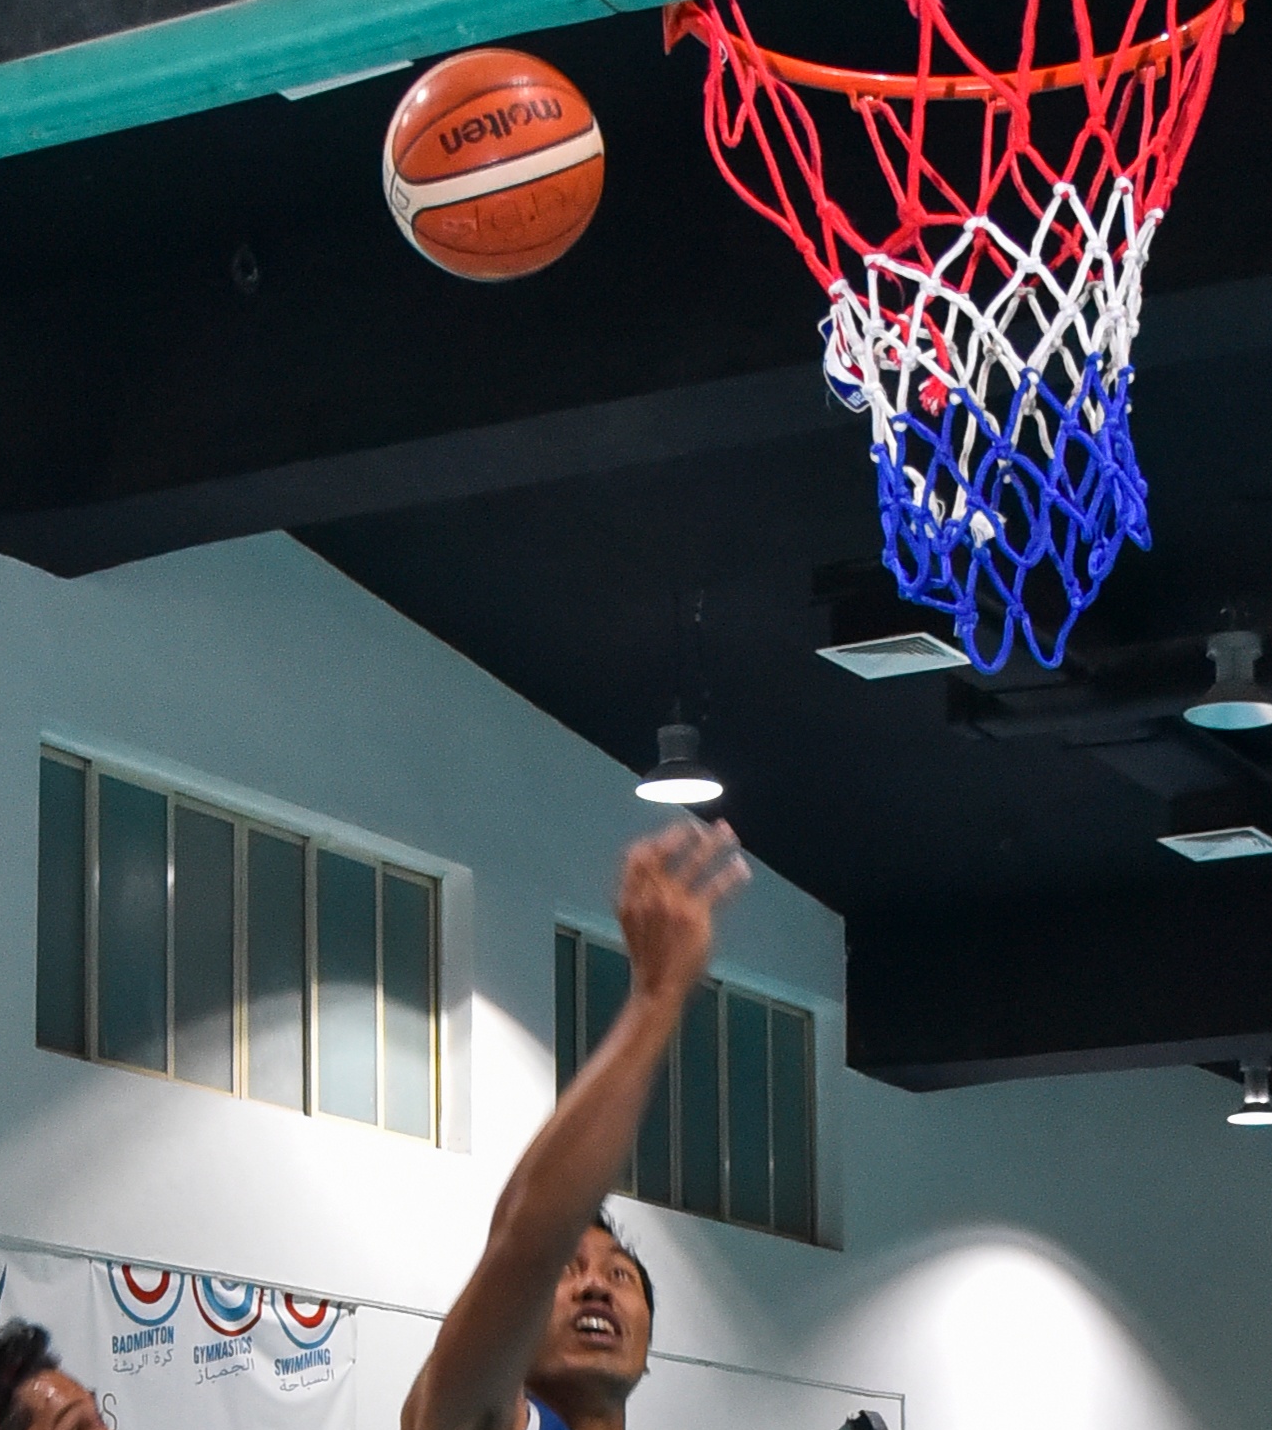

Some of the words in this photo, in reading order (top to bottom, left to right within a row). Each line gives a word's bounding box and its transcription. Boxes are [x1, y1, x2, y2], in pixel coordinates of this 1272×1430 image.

[439, 96, 563, 155] molten
[112, 1326, 175, 1355] BADMINTON
[193, 1336, 253, 1365] GYMNASTICS
[112, 1354, 149, 1375] الريشة
[154, 1348, 175, 1367] كرة
[274, 1347, 331, 1377] SWIMMING
[195, 1358, 255, 1386] الجمباز
[279, 1369, 335, 1393] السباحة
